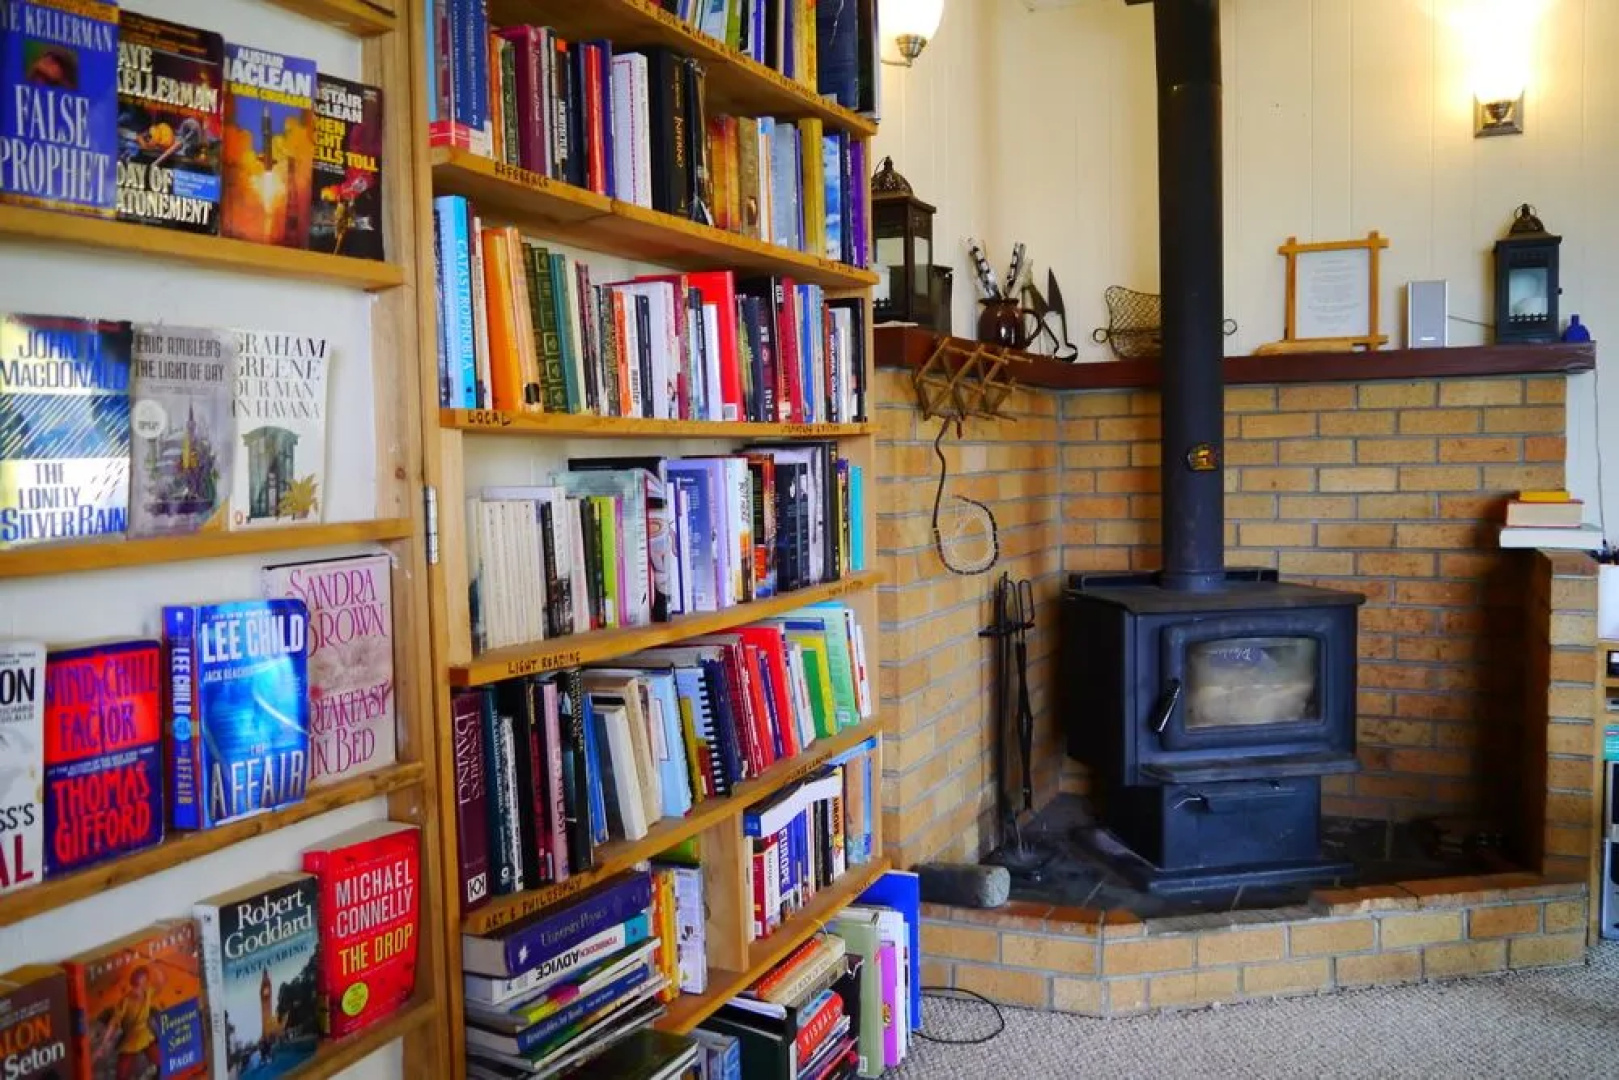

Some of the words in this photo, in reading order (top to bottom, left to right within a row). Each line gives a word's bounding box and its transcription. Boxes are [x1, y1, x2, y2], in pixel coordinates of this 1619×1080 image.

[25, 5, 113, 53] KELLERMAN
[14, 84, 90, 149] FALSE
[0, 136, 111, 204] PROPHET
[149, 163, 174, 194] OF
[135, 360, 157, 378] THE
[158, 361, 189, 380] LIGHT
[190, 362, 203, 380] OF
[204, 363, 225, 383] DAY
[276, 380, 315, 399] MAN
[256, 400, 321, 420] HAVANA
[468, 410, 512, 427] LOCAL
[286, 569, 377, 612] SANDRA
[202, 619, 243, 663] LEE
[246, 613, 304, 658] CHILD
[172, 647, 190, 673] LEE
[507, 660, 537, 675] LIGHT
[172, 675, 192, 714] CHILD
[309, 736, 331, 780] IN
[336, 727, 375, 772] BED
[52, 760, 150, 829] THOMAS
[211, 750, 305, 820] AFFAIR
[55, 801, 152, 864] GIFFORD
[779, 829, 791, 889] EUROPE
[335, 857, 414, 909] MICHAEL
[237, 889, 305, 931] Robert
[336, 885, 414, 938] CONNELLY
[225, 905, 313, 959] Goddard
[338, 941, 369, 977] THE
[374, 922, 414, 962] DROP
[235, 961, 264, 981] PAST
[265, 944, 309, 970] CARING
[536, 950, 580, 981] ADVICE
[0, 1013, 52, 1056] LON
[803, 1011, 833, 1045] VISUAL
[4, 1040, 66, 1080] Seton
[169, 1050, 196, 1072] PAGE
